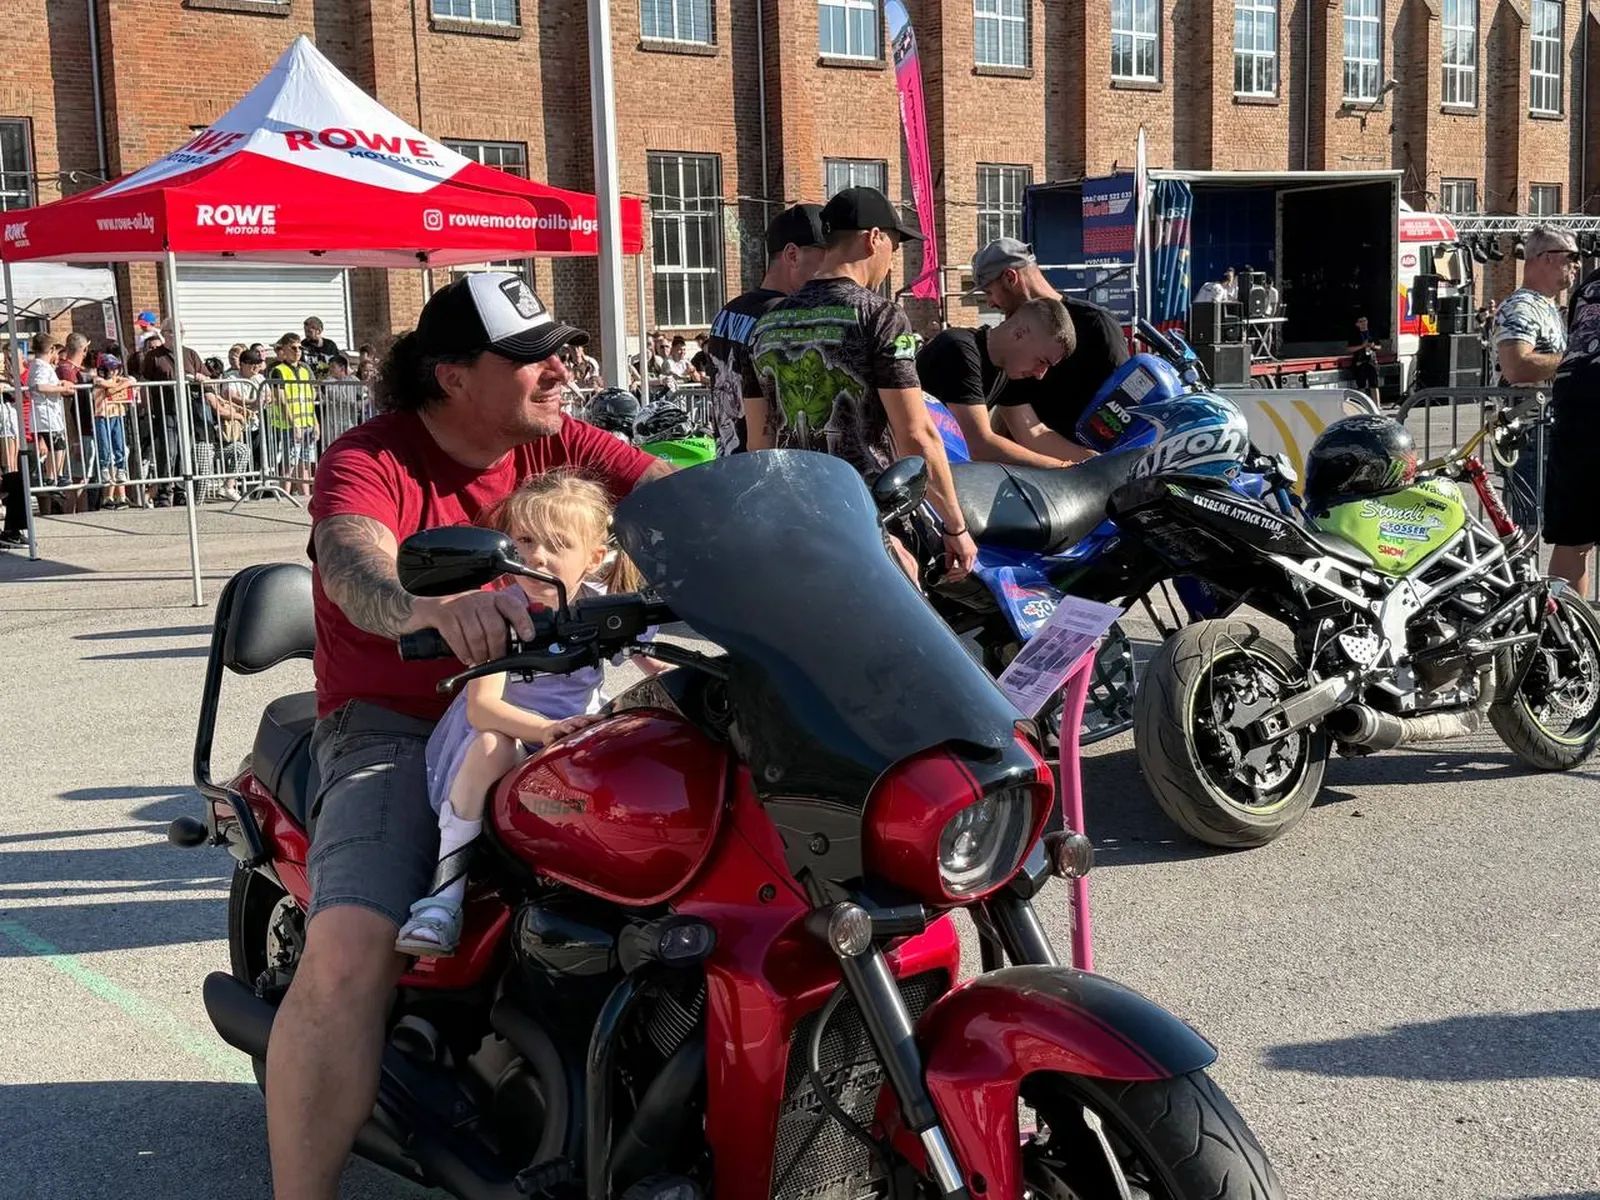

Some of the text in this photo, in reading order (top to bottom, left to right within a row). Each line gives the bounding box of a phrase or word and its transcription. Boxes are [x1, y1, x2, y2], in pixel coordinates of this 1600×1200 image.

[283, 128, 435, 158] ROWE
[348, 150, 445, 168] MOTOR OIL
[96, 212, 154, 233] www.rowe-oil.bg
[196, 204, 276, 226] ROWE
[449, 213, 599, 235] rowemotoroilbulga
[225, 226, 277, 235] MOTOR OIL
[1105, 400, 1131, 424] AUTO
[1193, 494, 1282, 532] EXTREME ATTACK TEAM
